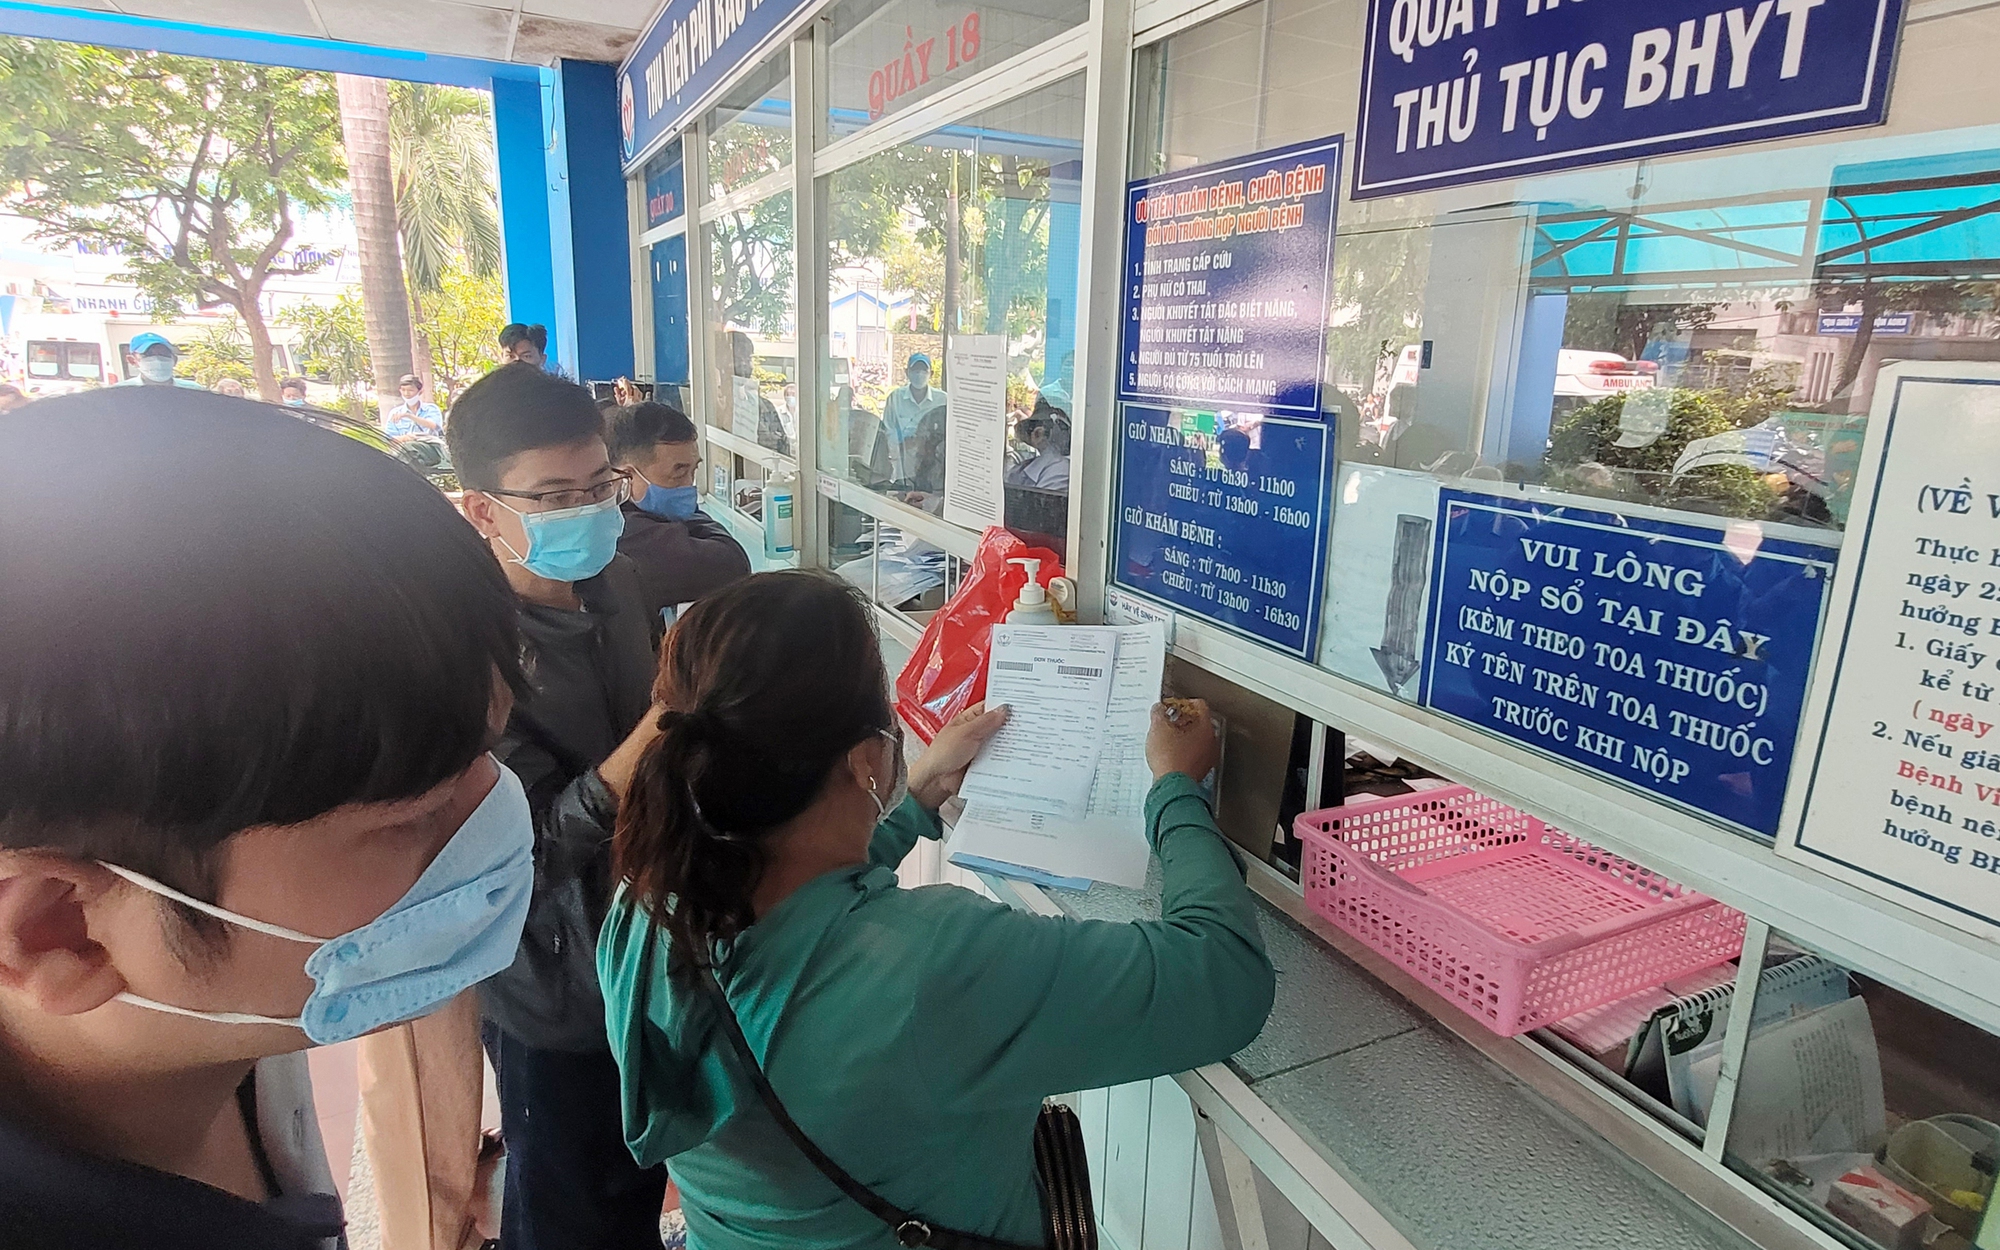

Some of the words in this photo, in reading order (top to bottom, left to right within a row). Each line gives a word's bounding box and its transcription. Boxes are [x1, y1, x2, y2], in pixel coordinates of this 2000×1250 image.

[645, 53, 664, 120] THU
[663, 19, 689, 105] VIỆN
[868, 25, 935, 121] QUẦY
[946, 11, 981, 72] 18
[1393, 47, 1482, 154] THỦ
[1499, 42, 1608, 142] TỤC
[1623, 0, 1827, 109] BHYT
[1150, 191, 1174, 221] TIÊN
[1175, 185, 1208, 217] KHÁM
[1209, 180, 1246, 214] BỆNH,
[1248, 169, 1283, 205] CHỮA
[1284, 163, 1325, 202] BỆNH
[1146, 221, 1161, 247] ĐỐI
[1178, 215, 1214, 243] TRƯỜNG
[1214, 212, 1236, 241] HỢP
[1236, 206, 1271, 235] NGƯỜI
[1270, 202, 1304, 234] BỆNH
[1134, 263, 1142, 276] 1.
[1163, 257, 1191, 276] TRẠNG
[1192, 250, 1211, 271] CẤP
[1212, 250, 1232, 269] CỨU
[76, 297, 127, 310] NHANH
[1133, 285, 1141, 299] 2.
[1142, 283, 1158, 300] PHỤ
[1160, 279, 1173, 297] NỮ
[1173, 277, 1185, 297] CÓ
[1132, 307, 1139, 321] 3.
[1166, 300, 1199, 320] KHUYẾT
[1200, 301, 1217, 322] TẬT
[1218, 301, 1237, 321] ĐẶC
[1239, 299, 1263, 321] BIỆT
[1264, 298, 1298, 321] NẶNG,
[1165, 324, 1198, 343] KHUYẾT
[1199, 325, 1216, 346] TẬT
[1217, 326, 1244, 347] NẶNG
[1129, 351, 1137, 365] 4.
[1177, 349, 1189, 366] TỪ
[1189, 352, 1200, 367] 75
[1202, 347, 1222, 368] TUỔI
[1224, 349, 1243, 368] TRỞ
[1243, 350, 1264, 369] LÊN
[1128, 373, 1136, 386] 5.
[1163, 371, 1174, 388] CÓ
[1217, 373, 1243, 393] CÁCH
[1245, 378, 1277, 398] MẠNG
[1128, 419, 1147, 441] GIỜ
[1169, 456, 1197, 477] SÁNG
[1221, 468, 1248, 488] 6h30
[1259, 476, 1295, 498] 11h00
[1917, 477, 1973, 515] (VỀ
[1168, 478, 1199, 503] CHIỀU
[1207, 488, 1223, 508] TỪ
[1225, 495, 1258, 517] 13h00
[1273, 506, 1310, 529] 16h00
[1124, 505, 1143, 526] GIỜ
[1144, 512, 1179, 537] KHÁM
[1181, 519, 1215, 547] BỆNH
[1519, 537, 1582, 572] VUI
[1591, 550, 1706, 597] LÒNG
[1915, 537, 1980, 564] Thực
[1164, 545, 1190, 568] SÁNG
[1198, 556, 1213, 575] TỪ
[1215, 562, 1241, 584] 7h00
[1250, 574, 1287, 599] 11h30
[1905, 572, 1971, 599] ngày
[1162, 568, 1193, 592] CHIỀU
[1200, 581, 1215, 600] TỪ
[1217, 589, 1250, 613] 13h00
[1263, 605, 1300, 631] 16h30
[1468, 568, 1531, 602] NỘP
[1540, 578, 1585, 615] SỔ
[1597, 598, 1665, 636] TẠI
[1674, 618, 1771, 661] ĐÂY
[1899, 600, 1982, 636] hưởng
[1458, 604, 1516, 641] (KÈM
[1520, 622, 1586, 660] THEO
[1593, 642, 1646, 679] TOA
[1654, 658, 1768, 717] THUỐC)
[1894, 631, 1915, 651] 1.
[1926, 638, 1987, 669] Giấy
[1444, 641, 1476, 669] KÝ
[1481, 652, 1526, 685] TÊN
[1531, 668, 1600, 709] TRÊN
[1605, 691, 1660, 730] TOA
[1668, 709, 1775, 766] THUỐC
[1919, 668, 1954, 691] kể
[1961, 681, 1995, 702] từ
[1491, 696, 1569, 742] TRƯỚC
[1575, 725, 1626, 763] KHI
[1630, 744, 1691, 785] NỘP
[1871, 720, 1893, 741] 2.
[1902, 729, 1953, 758] Nếu
[1927, 707, 1995, 739] ngày
[1896, 759, 1963, 795] Bệnh
[1890, 788, 1953, 825] bệnh
[1882, 818, 1963, 864] hưởng
